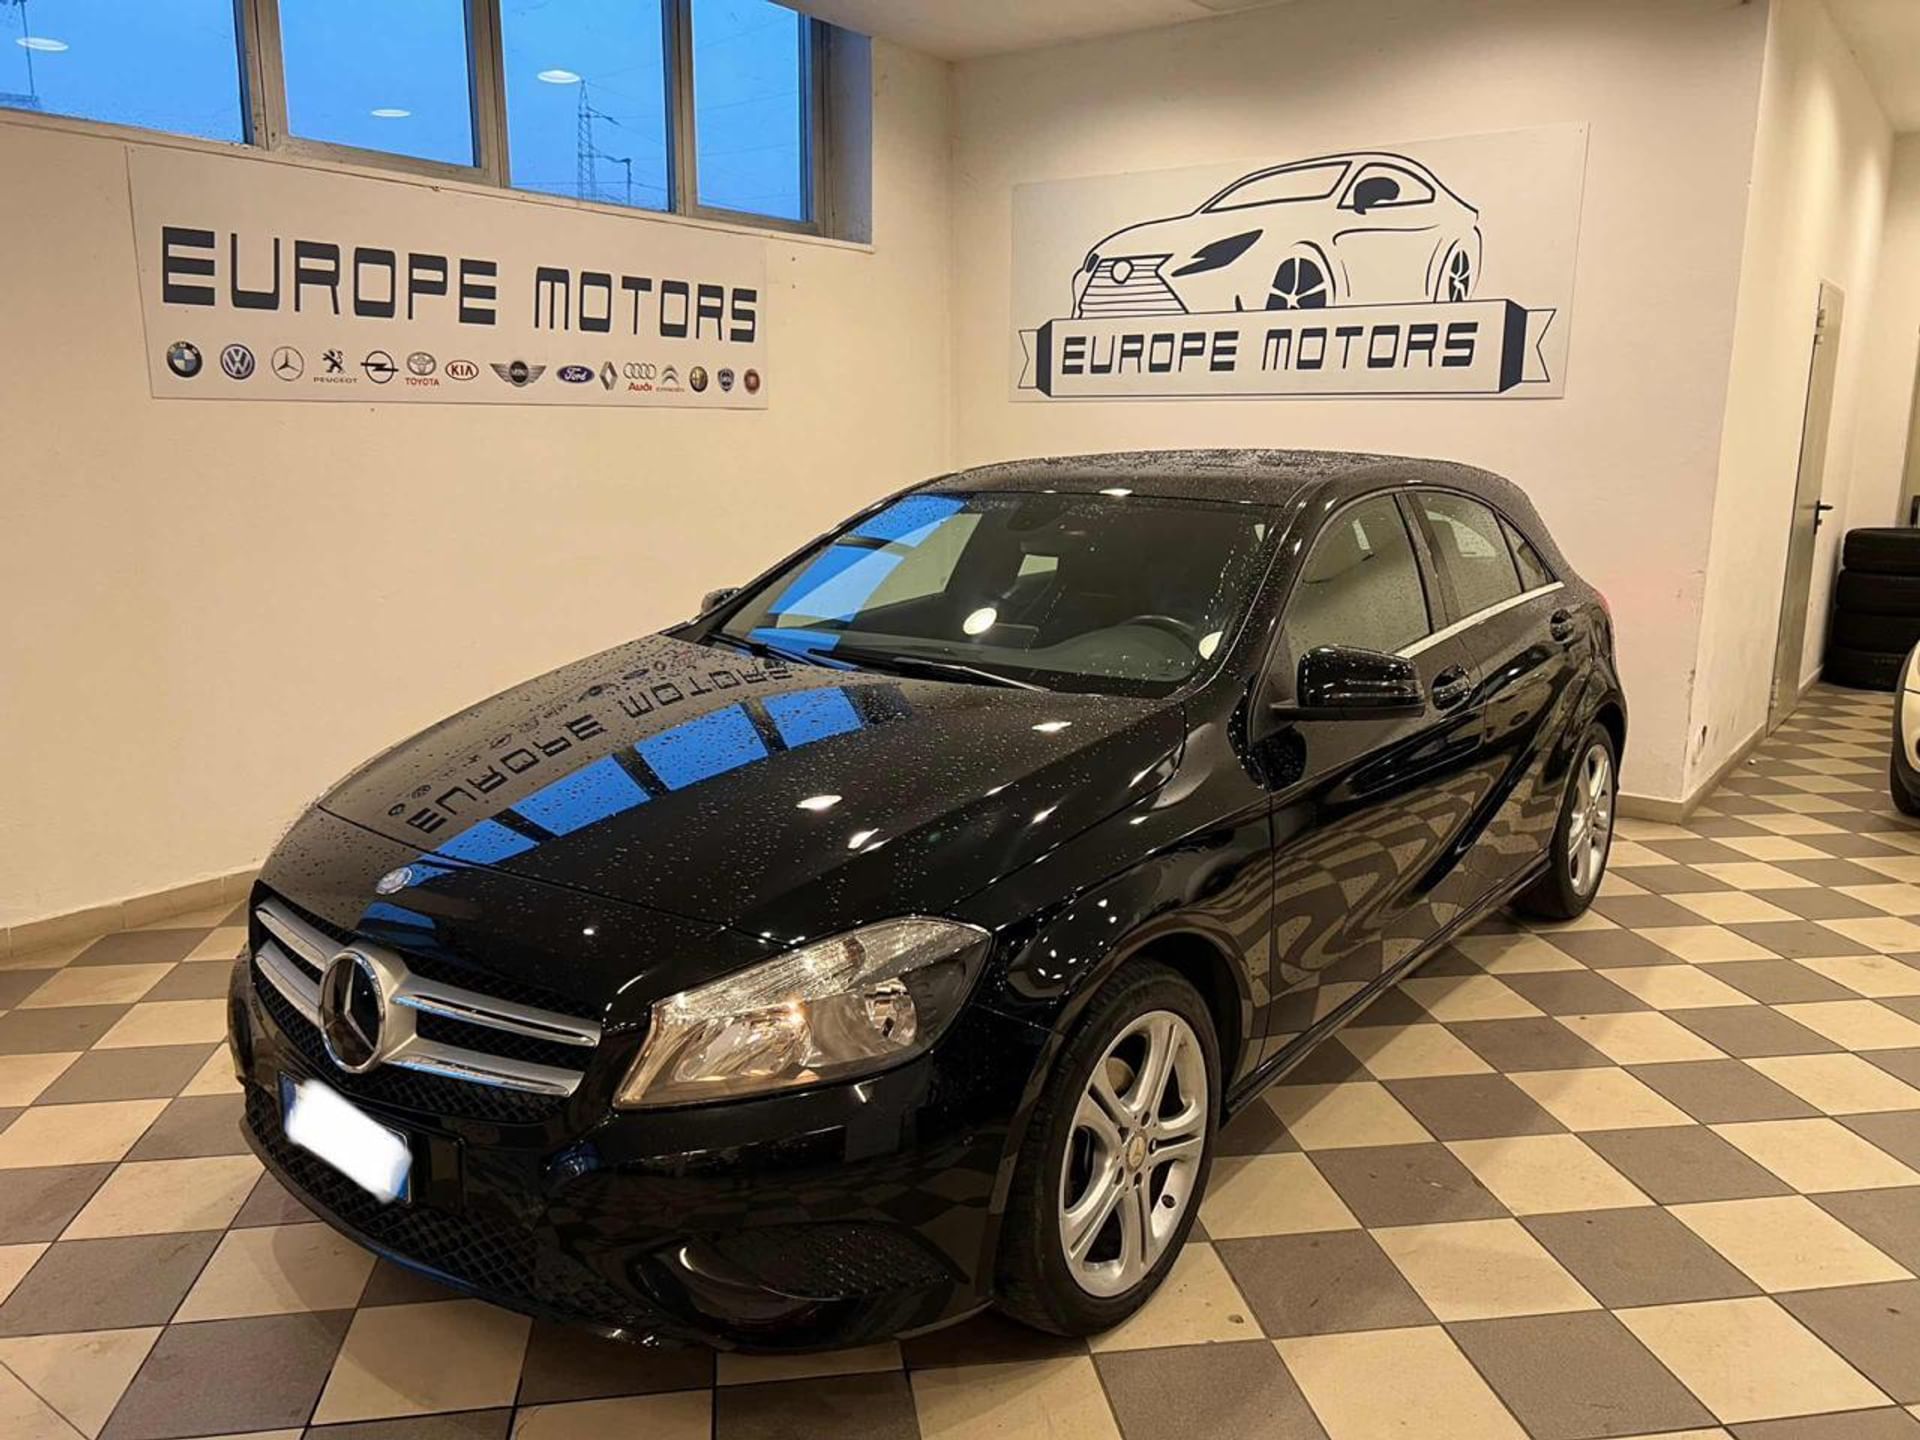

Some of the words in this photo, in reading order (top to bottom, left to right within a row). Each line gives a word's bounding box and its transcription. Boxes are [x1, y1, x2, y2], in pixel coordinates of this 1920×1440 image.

[162, 226, 498, 326] EUROPE
[534, 266, 758, 343] MOTORS
[1062, 331, 1239, 374] EUROPE
[1262, 322, 1479, 371] MOTORS
[405, 377, 440, 386] TOYOTA
[628, 381, 653, 392] Audi
